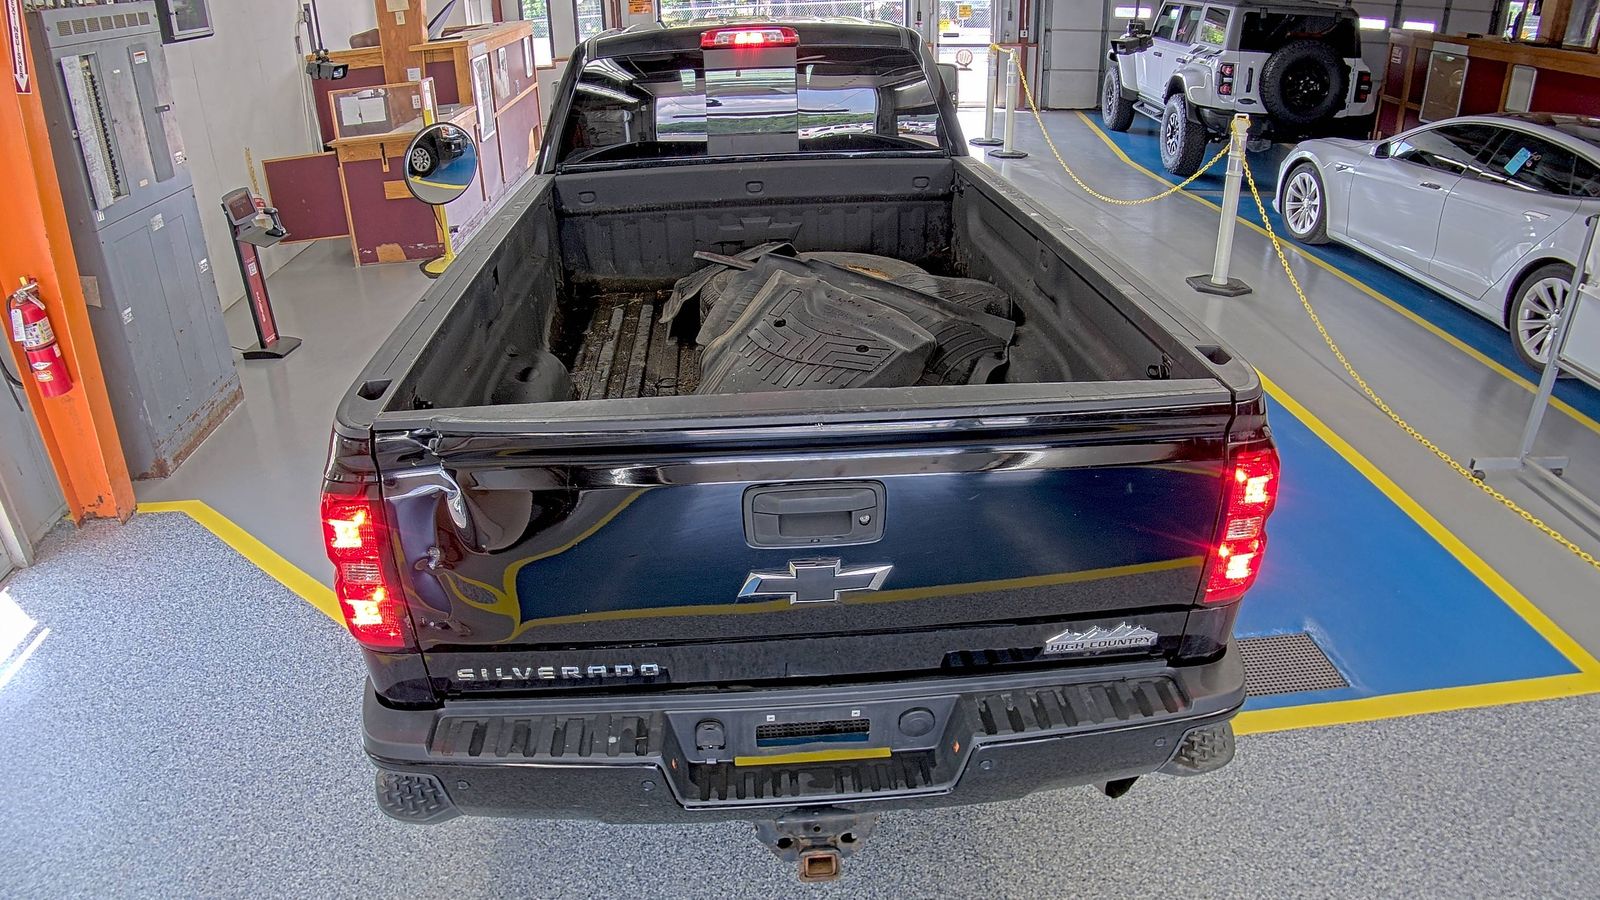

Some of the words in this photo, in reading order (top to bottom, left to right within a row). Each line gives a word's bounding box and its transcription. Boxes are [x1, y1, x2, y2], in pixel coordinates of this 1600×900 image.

[1050, 642, 1085, 652] HIGH
[1089, 636, 1154, 648] COUNTRY
[456, 663, 660, 681] SILVERADO
